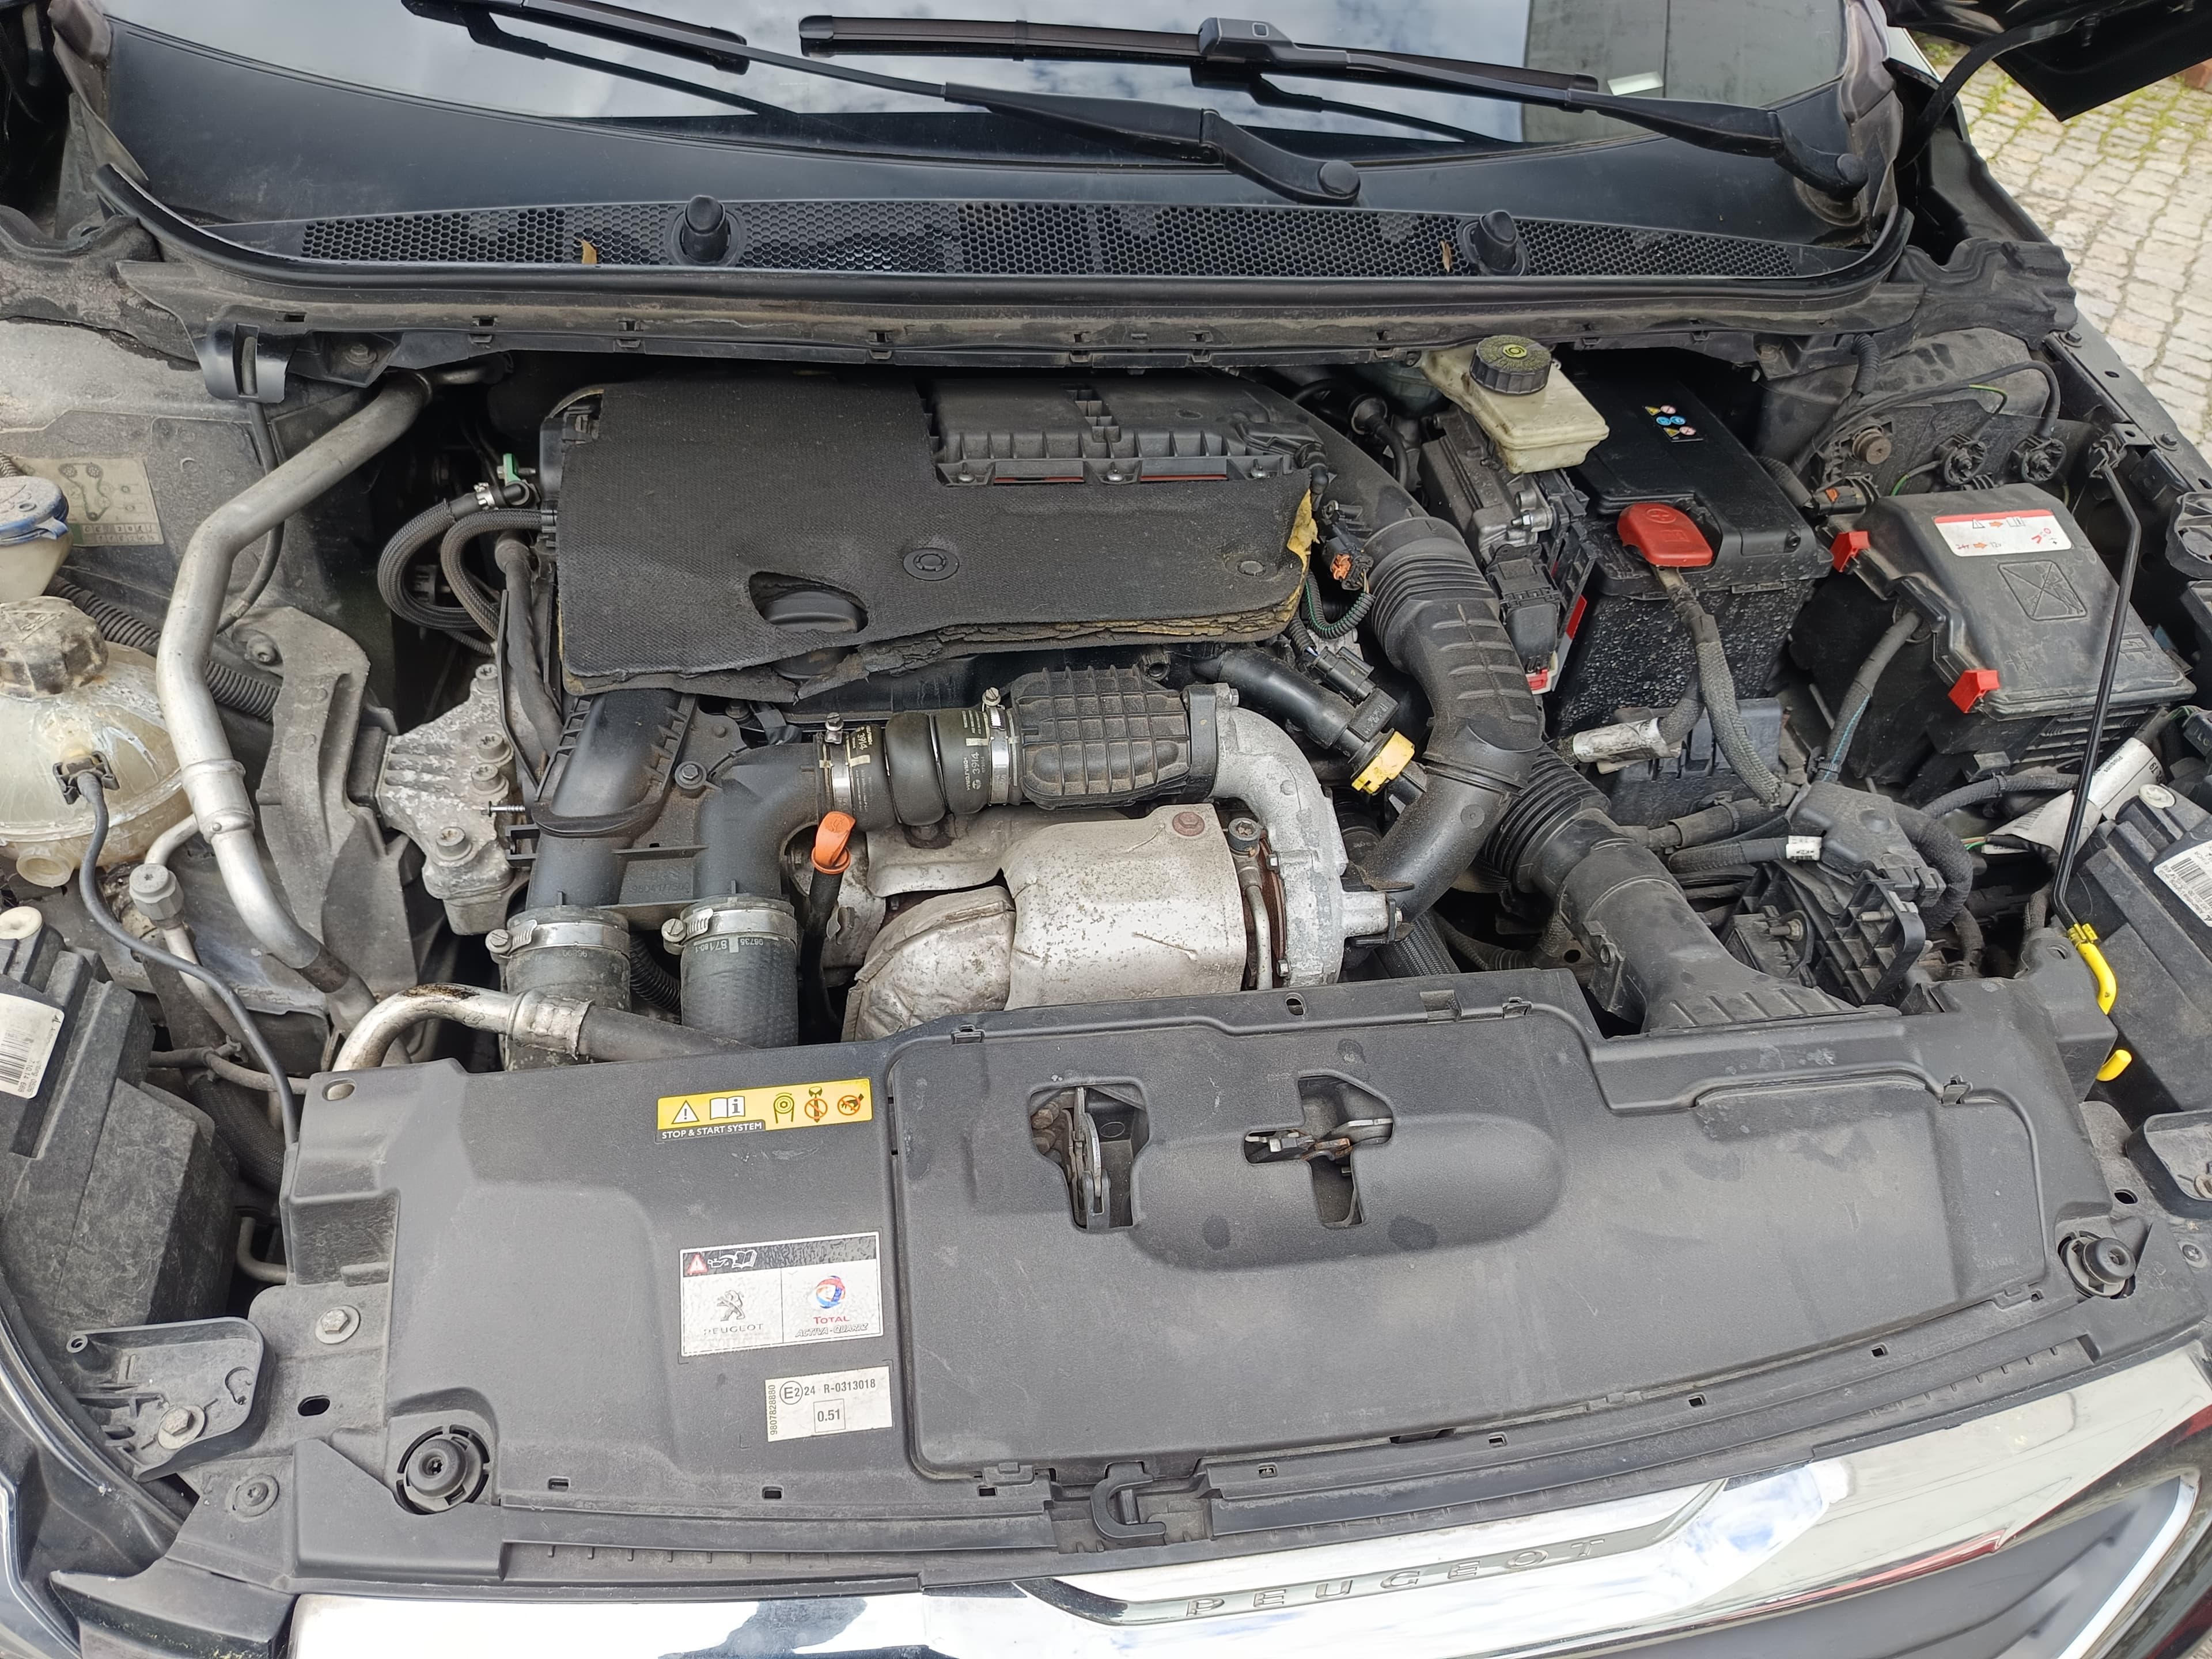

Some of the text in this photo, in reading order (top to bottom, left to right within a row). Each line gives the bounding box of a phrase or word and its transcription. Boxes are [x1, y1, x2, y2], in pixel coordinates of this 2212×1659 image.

[662, 1122, 762, 1139] STOP & START SYSTEM
[804, 1385, 816, 1396] 24
[824, 1378, 876, 1394] R-0313018
[768, 1384, 778, 1435] 9807828880
[817, 1408, 840, 1422] 0.51
[1185, 1537, 1605, 1618] PEUGEOT
